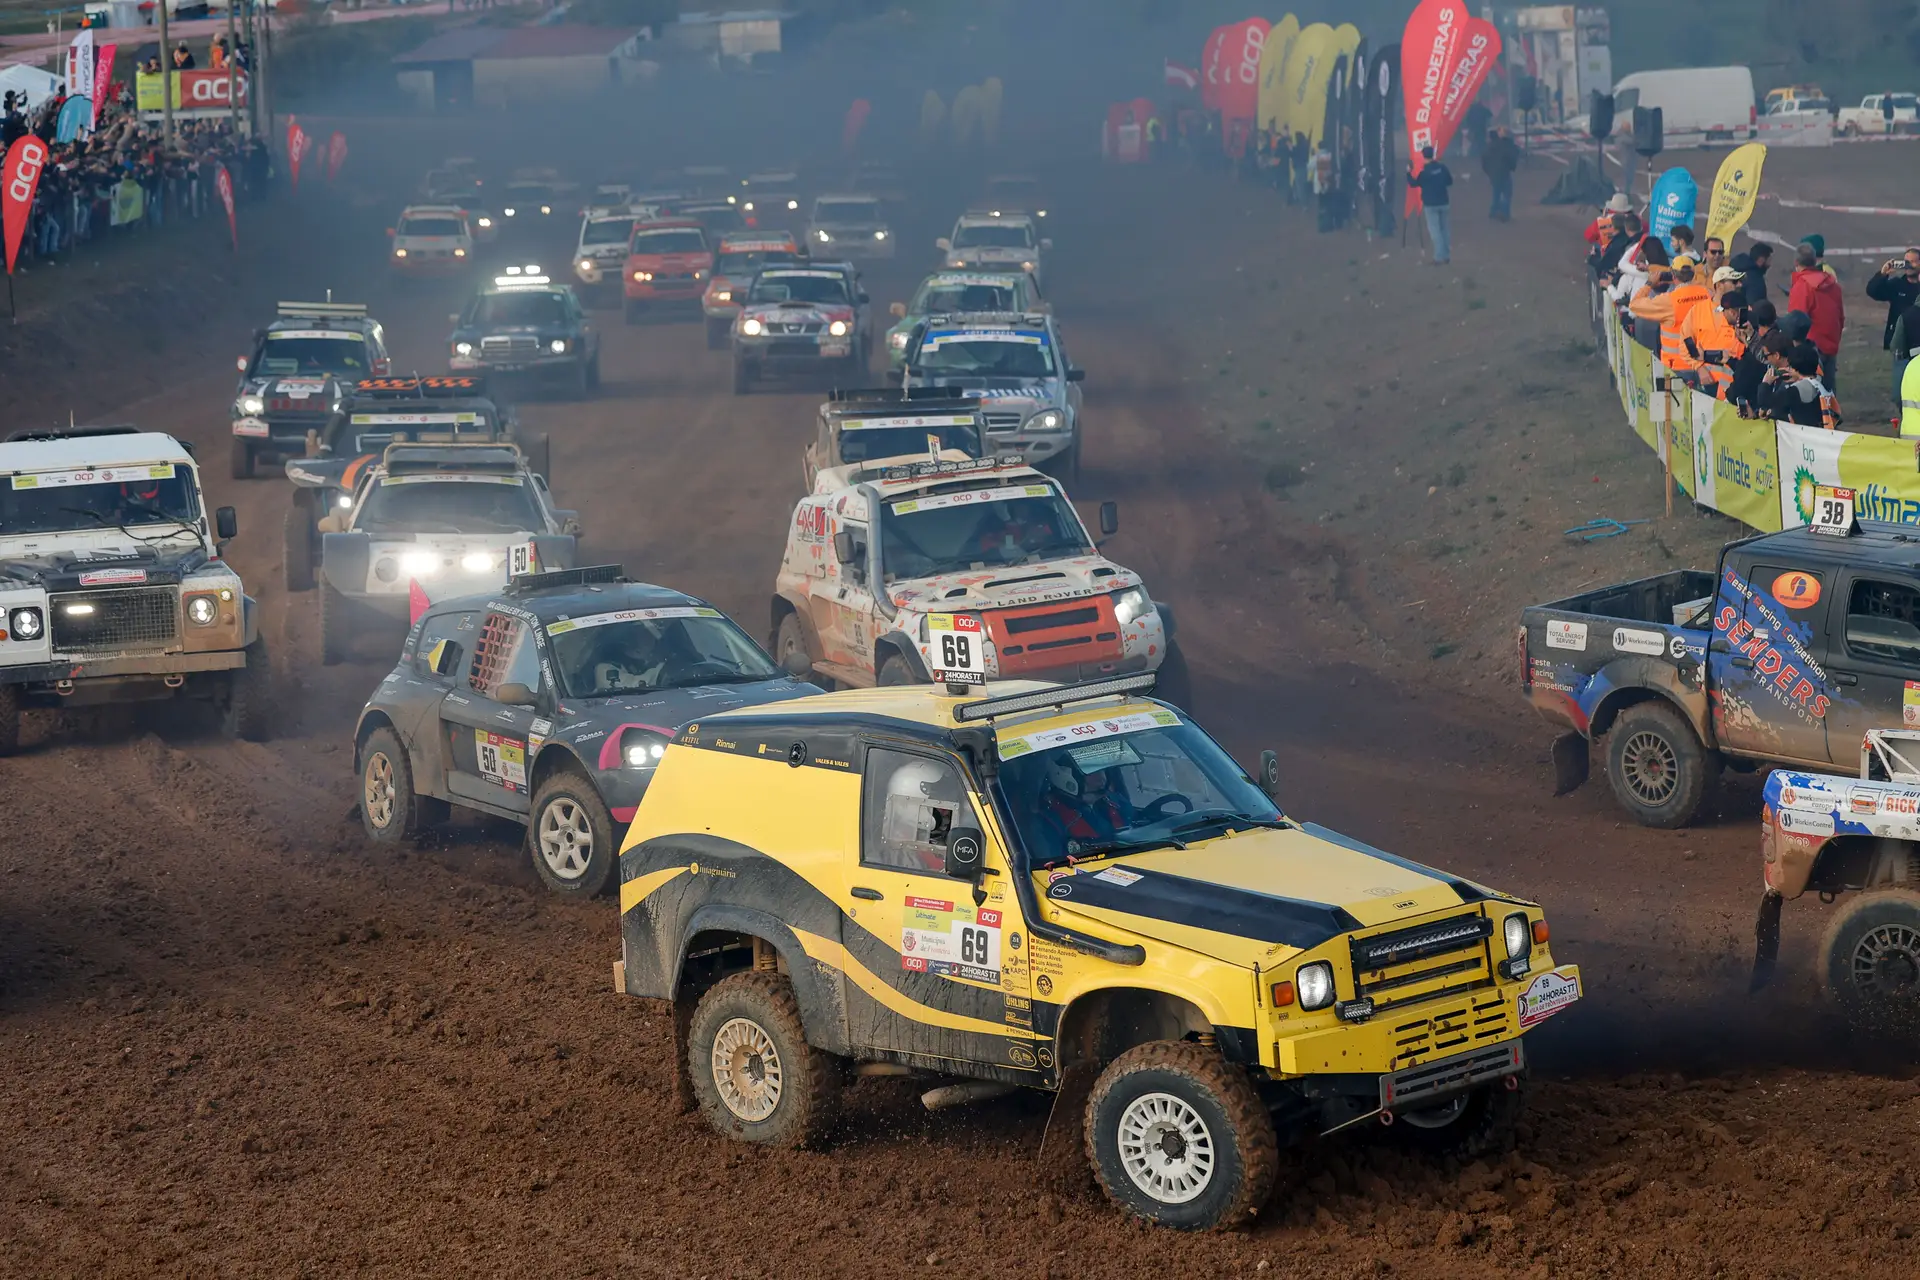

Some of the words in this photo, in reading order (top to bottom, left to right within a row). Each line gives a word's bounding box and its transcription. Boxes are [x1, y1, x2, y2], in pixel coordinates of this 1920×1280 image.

[1416, 8, 1454, 124] BANDEIRAS
[193, 78, 245, 102] acp
[10, 144, 43, 203] acp
[1802, 443, 1815, 466] bp
[1716, 445, 1751, 489] ultimate
[74, 472, 94, 482] acp
[952, 493, 972, 503] acp
[1821, 500, 1844, 525] 38
[514, 547, 527, 572] 50
[996, 596, 1037, 606] LAND
[1043, 588, 1093, 600] ROVER
[614, 612, 636, 620] acp
[958, 618, 975, 629] acp
[1725, 571, 1753, 599] Oeste
[1753, 595, 1782, 631] Racing
[1781, 625, 1828, 681] Competition
[534, 628, 546, 649] LINGE
[1549, 630, 1564, 638] TOTAL
[1564, 632, 1585, 641] ENERGY
[1556, 637, 1576, 646] SERVICE
[942, 635, 970, 668] 69
[1529, 657, 1551, 666] Oeste
[1714, 606, 1831, 718] SENDERS
[1529, 668, 1554, 680] Racing
[1529, 679, 1574, 693] Competition
[1753, 669, 1821, 730] TRANSPORT
[1071, 725, 1097, 736] acp
[715, 738, 736, 749] Rinnai
[482, 746, 497, 772] 50
[957, 845, 974, 855] MFA
[981, 912, 997, 923] acp
[962, 927, 988, 965] 69
[1036, 945, 1057, 954] Fernando
[1057, 950, 1077, 958] Azevedo
[906, 958, 922, 968] acp
[1048, 954, 1061, 962] Alves
[990, 971, 997, 979] TT
[1010, 967, 1028, 976] KAPCI
[1044, 967, 1063, 976] Cardoso
[1542, 979, 1550, 989] 69
[1567, 983, 1575, 993] TT
[1006, 994, 1030, 1010] ÖHLINS
